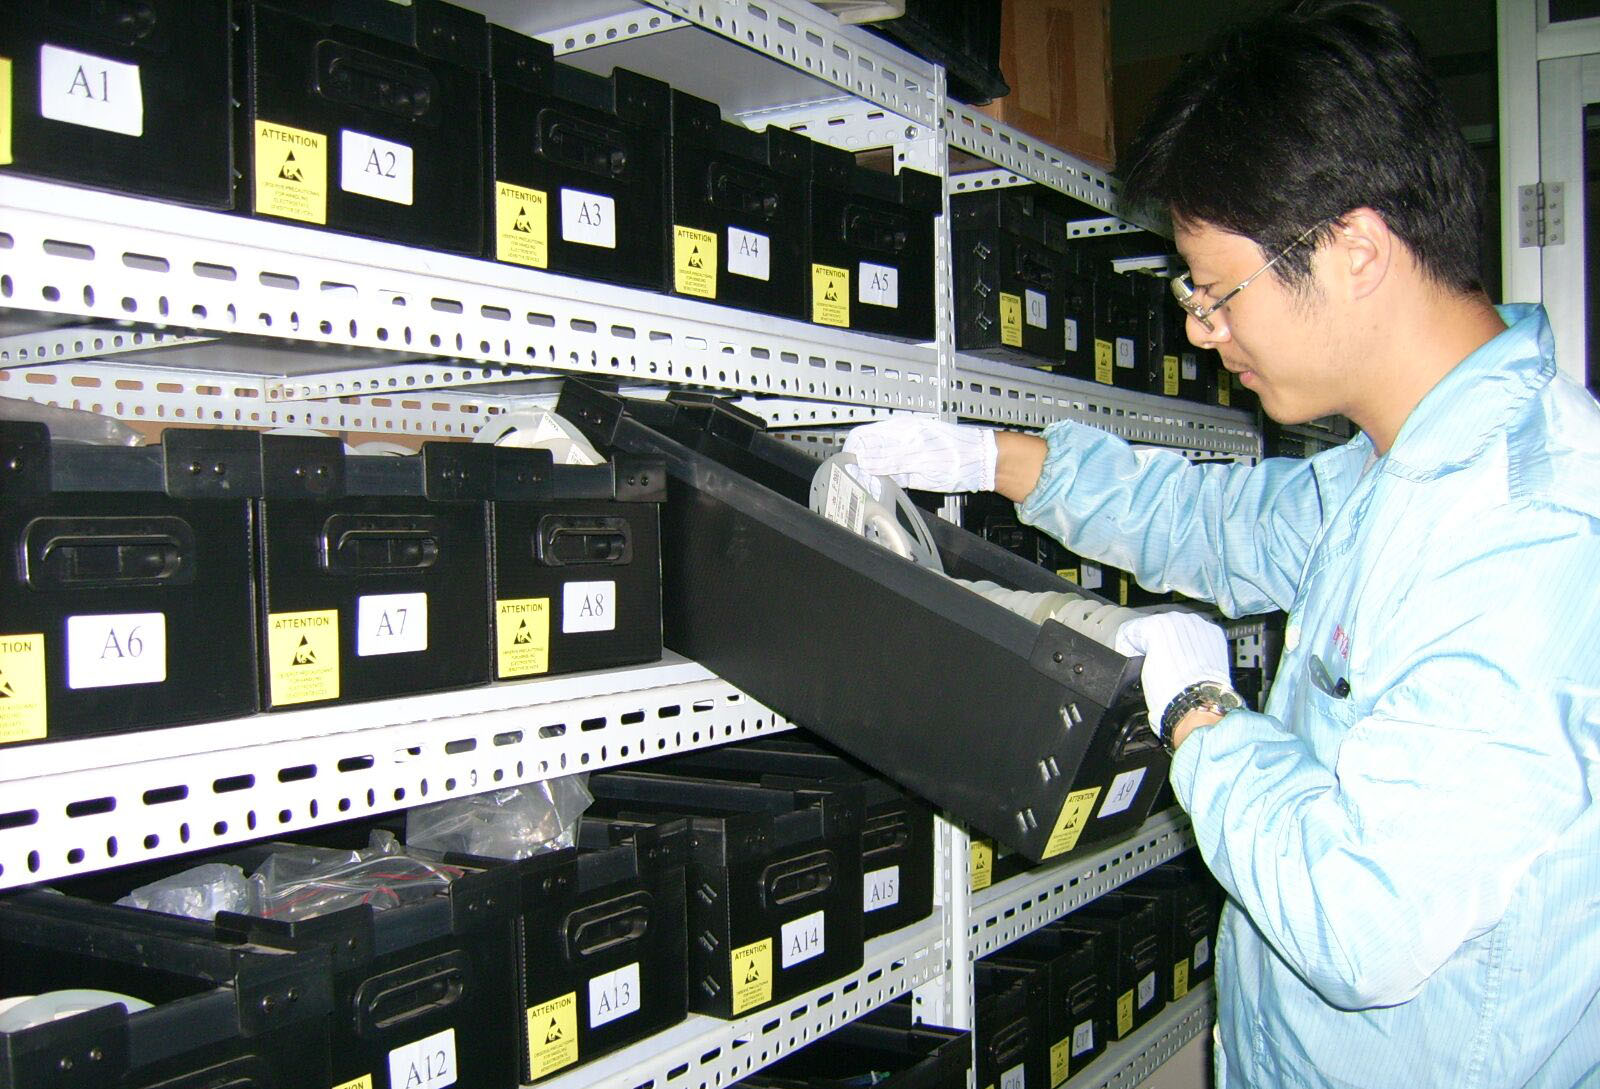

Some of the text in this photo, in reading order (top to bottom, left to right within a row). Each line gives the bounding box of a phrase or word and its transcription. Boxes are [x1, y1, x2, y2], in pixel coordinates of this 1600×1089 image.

[67, 64, 110, 102] A1
[261, 128, 318, 148] ATTENTION
[364, 147, 396, 178] A2
[501, 187, 542, 204] ATTENTION
[578, 201, 602, 226] A3
[677, 229, 712, 243] ATTENTION
[739, 234, 759, 258] A4
[816, 267, 846, 279] ATTENTION
[870, 272, 889, 292] A5
[501, 603, 543, 614] ATTENTION
[580, 593, 604, 618] A8
[275, 616, 330, 630] ATTENTION
[376, 608, 408, 637] A7
[99, 625, 143, 659] A6
[1111, 779, 1136, 804] A9
[871, 879, 894, 903] A15
[735, 943, 768, 961] ATTENTION
[790, 927, 819, 957] A14
[531, 997, 573, 1019] ATTENTION
[598, 982, 631, 1016] A13
[405, 1050, 449, 1089] A12
